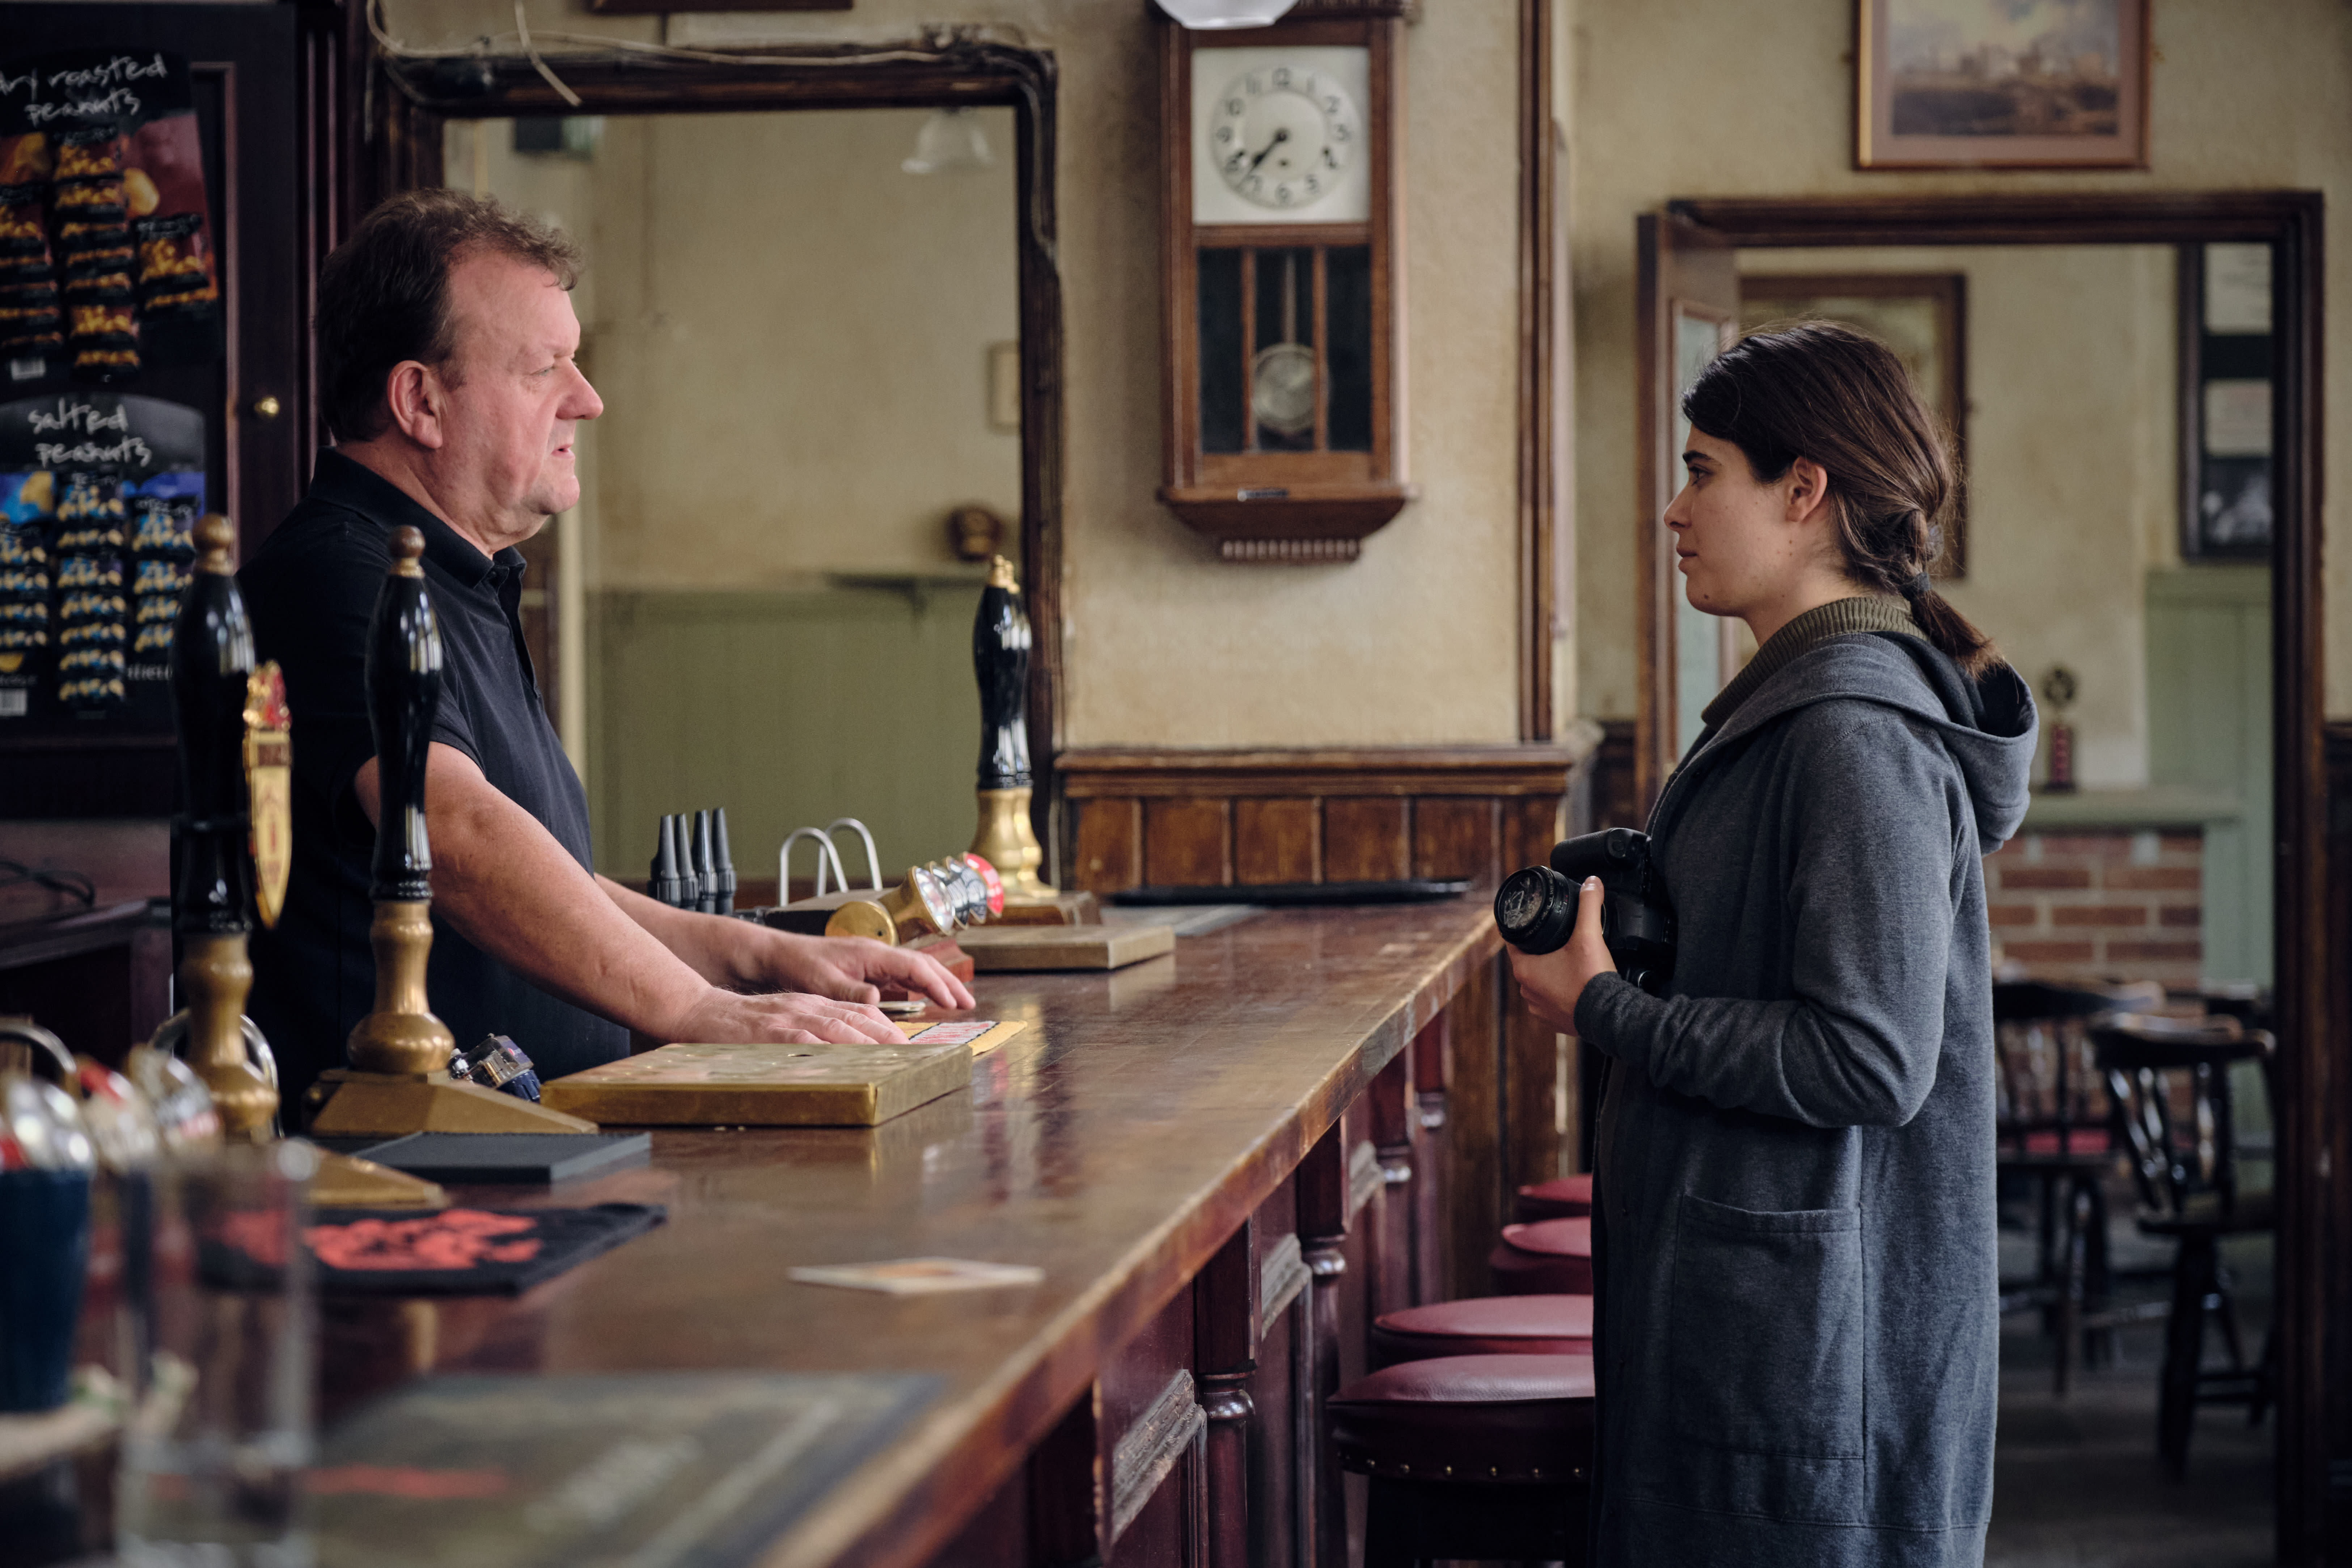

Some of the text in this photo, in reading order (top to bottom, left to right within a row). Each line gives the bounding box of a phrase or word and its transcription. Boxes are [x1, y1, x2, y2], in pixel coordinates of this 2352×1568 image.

[48, 52, 168, 88] roasted
[24, 87, 141, 127] peanuts
[28, 397, 129, 435] salted
[35, 435, 152, 469] peanuts
